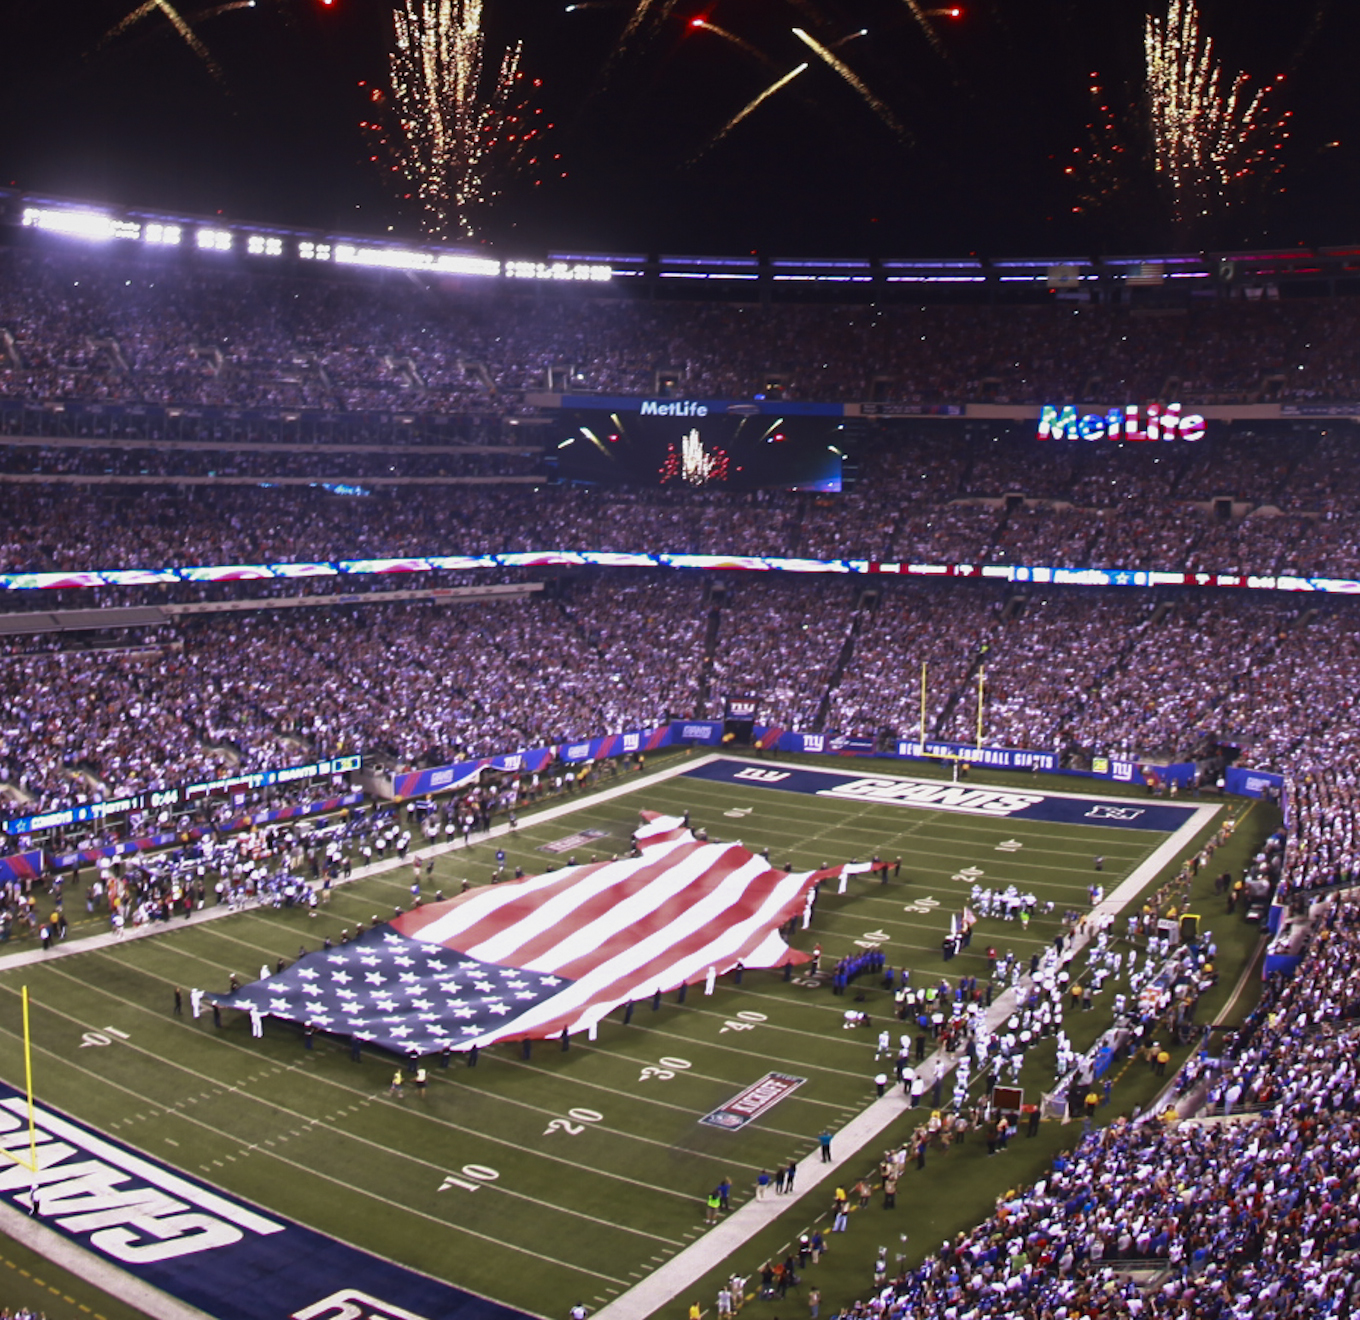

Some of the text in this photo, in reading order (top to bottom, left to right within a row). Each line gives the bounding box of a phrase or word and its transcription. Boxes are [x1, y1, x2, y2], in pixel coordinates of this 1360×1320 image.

[641, 401, 708, 418] MetLife
[1037, 402, 1207, 441] MetLife
[899, 743, 922, 756] NEW
[959, 748, 1009, 766] FOOTBALL
[1014, 753, 1053, 769] GIANTS
[820, 779, 1044, 814] GIANTS
[724, 1011, 768, 1031] 40
[641, 1056, 692, 1080] 30
[548, 1108, 603, 1135] 20
[443, 1164, 500, 1192] 10
